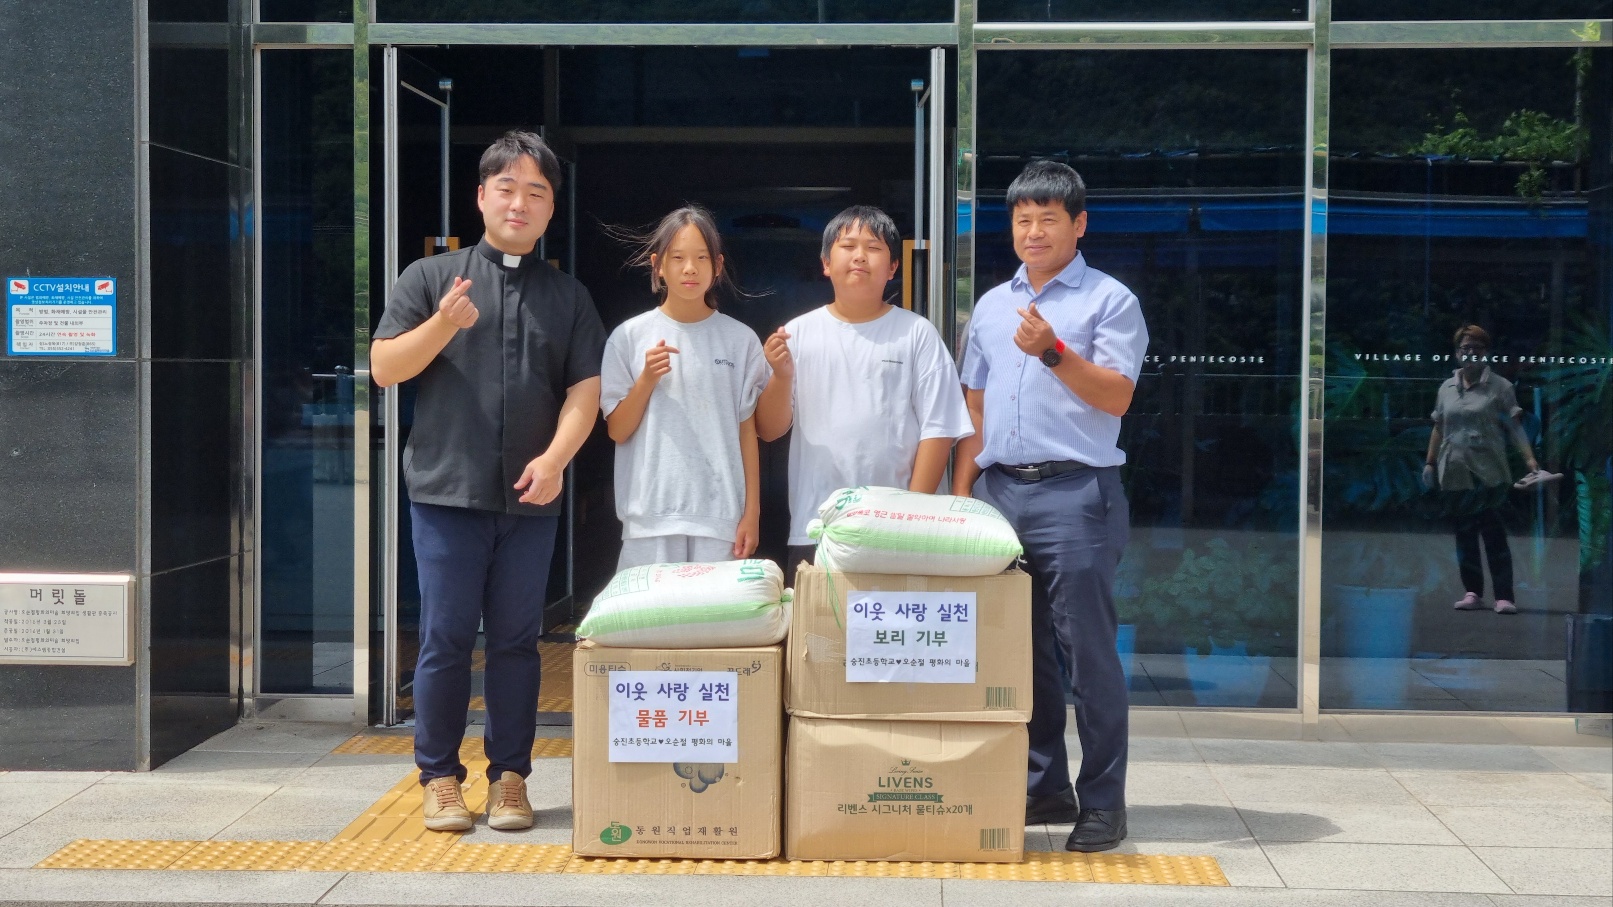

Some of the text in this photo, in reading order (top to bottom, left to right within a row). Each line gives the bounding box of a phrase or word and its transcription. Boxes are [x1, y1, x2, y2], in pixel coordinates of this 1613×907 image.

[33, 283, 90, 293] CCTV설치안내
[1170, 355, 1265, 364] PENTECOSTE
[1354, 353, 1422, 362] VILLAGE
[1432, 354, 1451, 362] OF
[1461, 355, 1509, 363] PEACE
[29, 588, 86, 606] 머릿돌
[853, 602, 969, 623] 이웃 사랑 실천
[873, 629, 948, 647] 보리 기부
[929, 658, 952, 668] 평화의
[956, 658, 971, 668] 마을
[616, 682, 730, 702] 이웃 사랑 실천
[636, 709, 710, 728] 물품 기부
[691, 737, 714, 748] 평화의
[717, 738, 733, 748] 마을
[878, 776, 934, 789] LIVENS
[837, 803, 973, 816] 리벤스 시그니처 물티슈x20개
